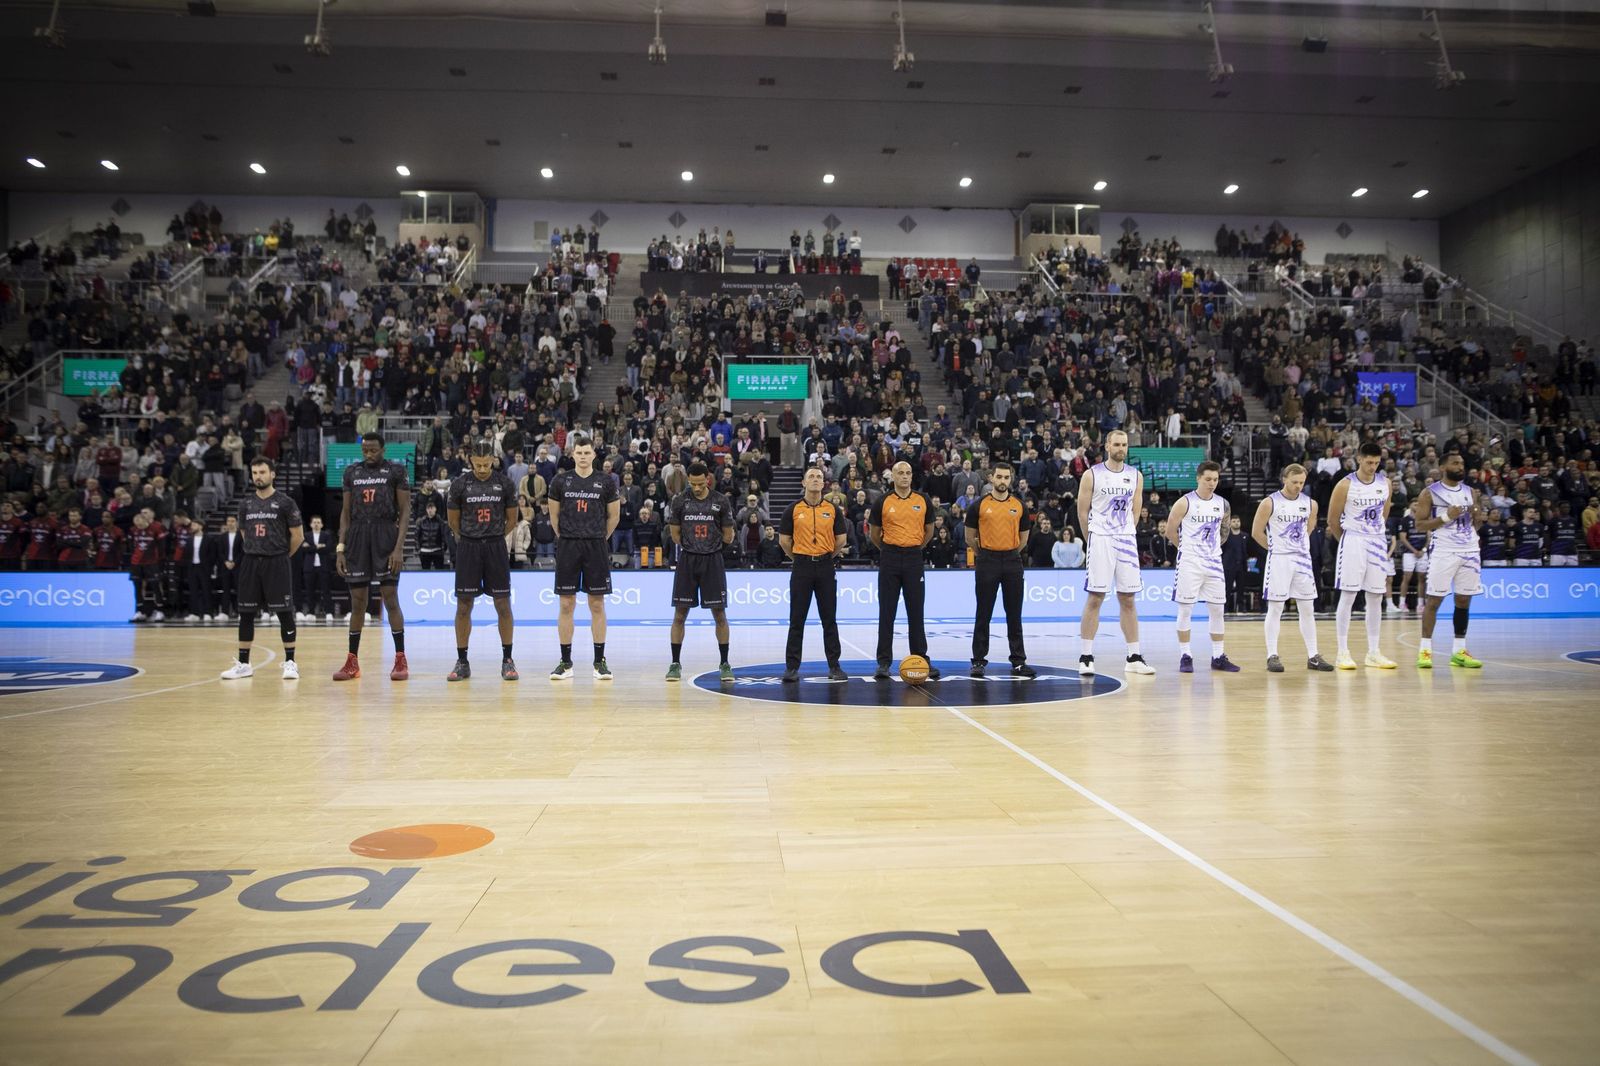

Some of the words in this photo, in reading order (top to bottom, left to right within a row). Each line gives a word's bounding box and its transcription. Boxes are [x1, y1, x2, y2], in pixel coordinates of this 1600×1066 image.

[737, 375, 798, 385] FIRMAFY
[363, 489, 376, 503] 37
[576, 500, 588, 513] 14
[1113, 499, 1127, 511] 32
[477, 508, 491, 522] 25
[1364, 509, 1377, 520] 10
[254, 523, 267, 538] 15
[1204, 527, 1211, 539] 7
[0, 583, 104, 606] endesa
[1481, 579, 1549, 599] ndesa
[0, 922, 1031, 1016] ndesa
